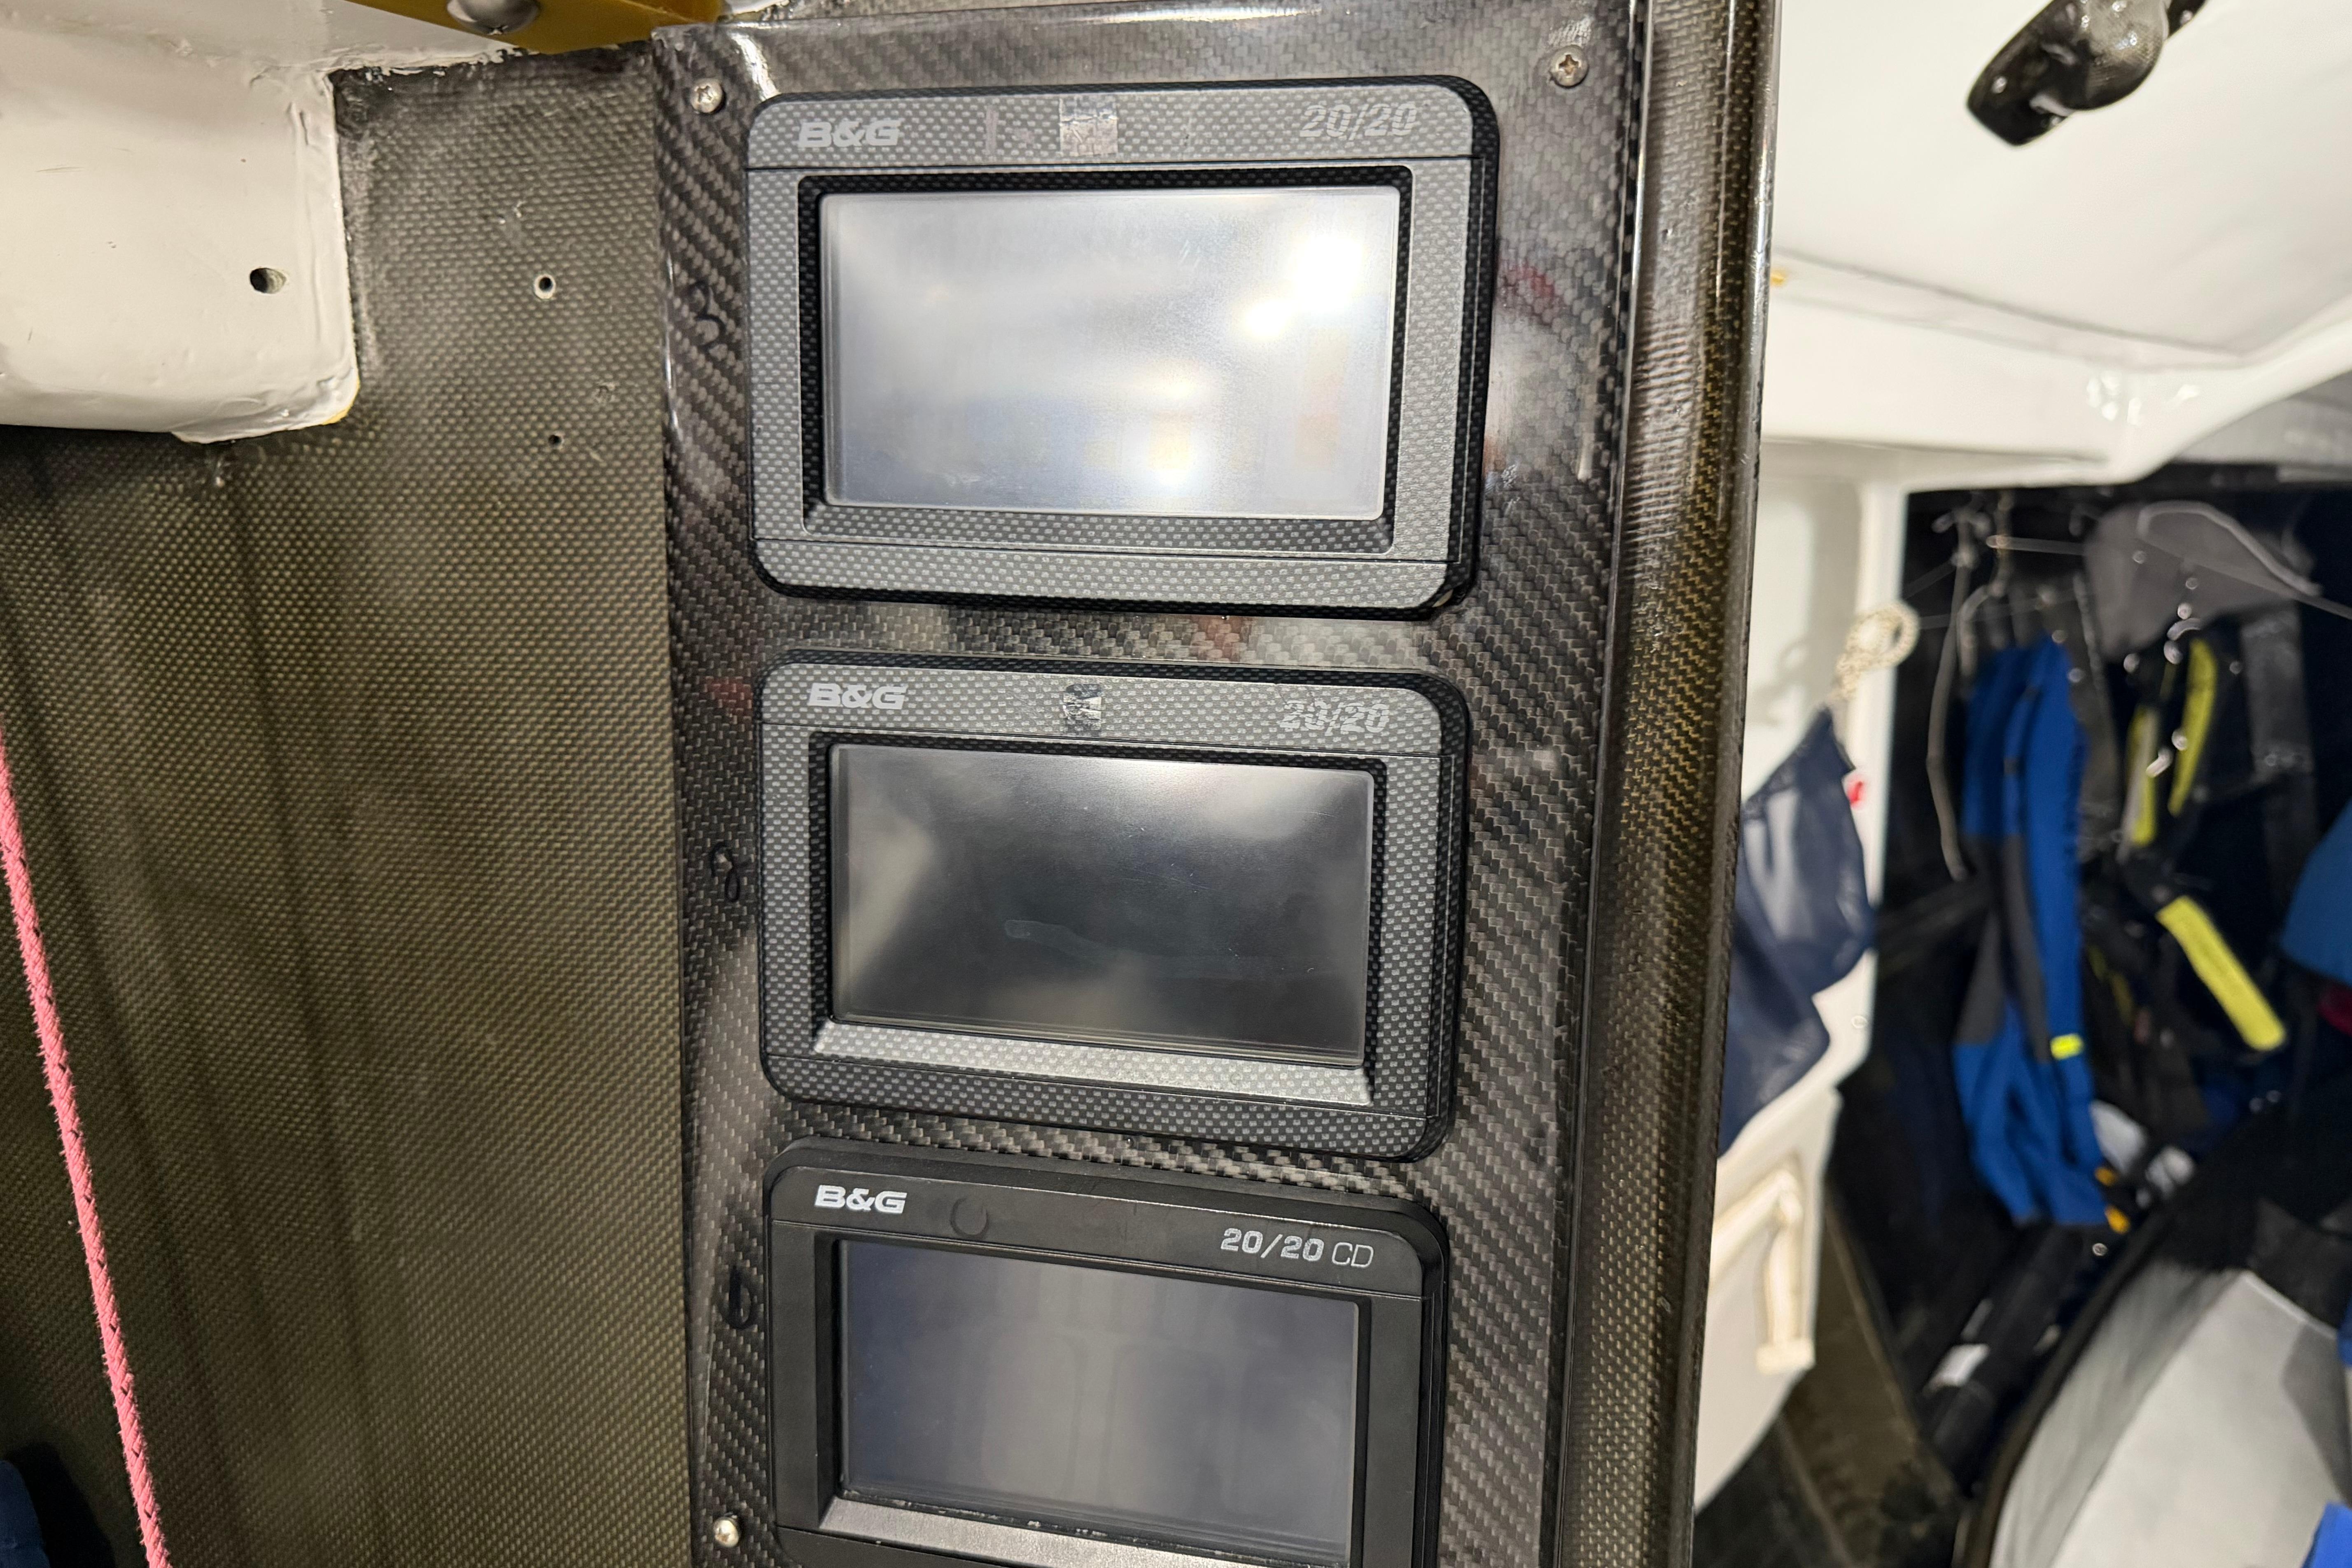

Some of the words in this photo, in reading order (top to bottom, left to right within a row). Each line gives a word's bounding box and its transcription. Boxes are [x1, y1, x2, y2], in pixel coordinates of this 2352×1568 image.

[798, 120, 901, 147] B&G
[1299, 103, 1417, 147] 20/20
[807, 682, 907, 709] B&G
[1277, 700, 1390, 736] 20/20
[814, 1184, 908, 1214] B&G
[1220, 1227, 1325, 1262] 20/20
[1332, 1242, 1374, 1268] CD
